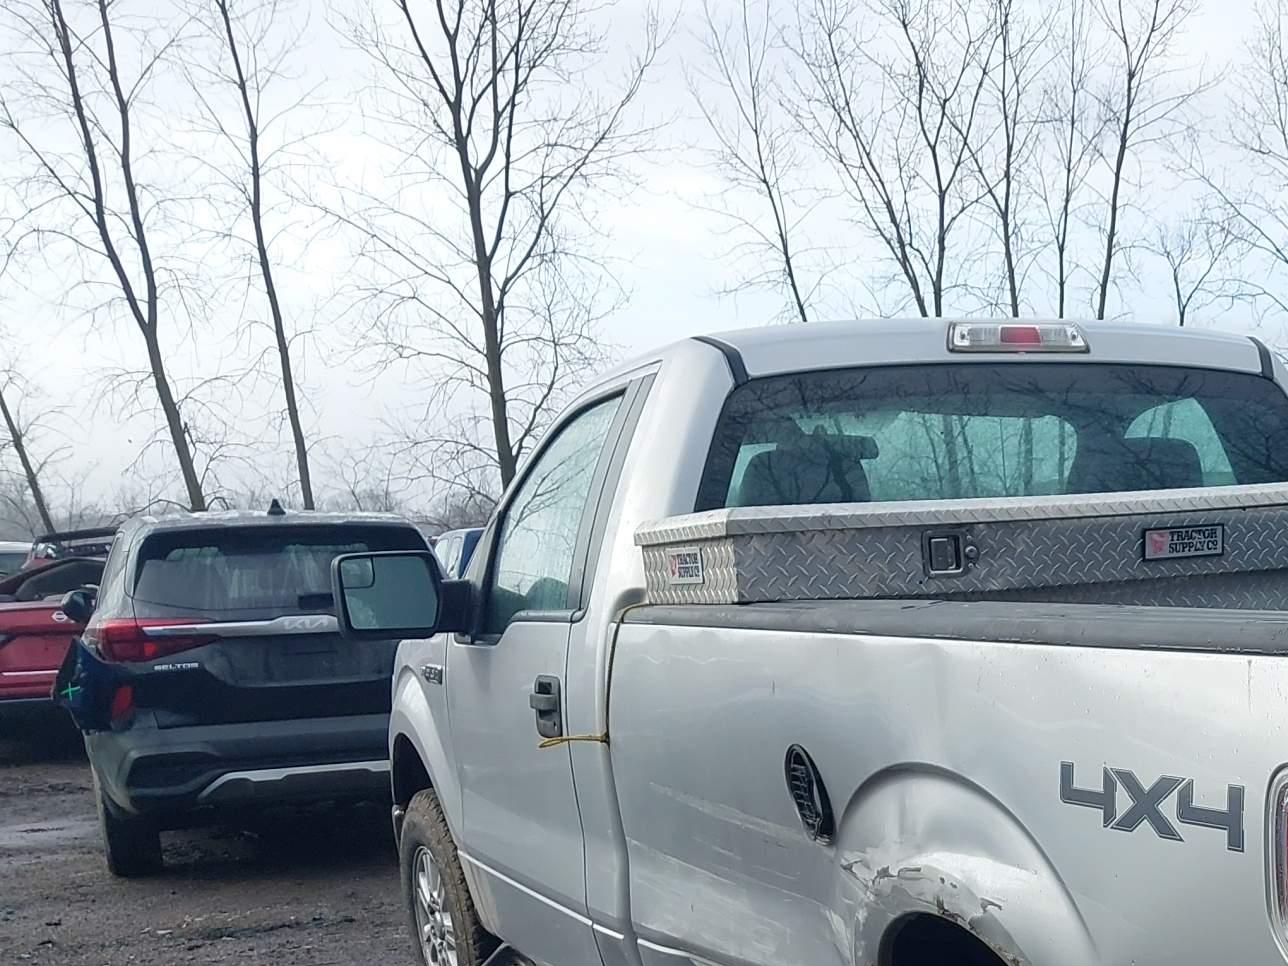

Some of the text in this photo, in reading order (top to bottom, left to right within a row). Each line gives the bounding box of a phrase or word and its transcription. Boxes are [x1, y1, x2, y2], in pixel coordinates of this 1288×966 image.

[1168, 527, 1218, 542] TRACTOR
[1168, 540, 1206, 554] SUPPLY
[284, 618, 328, 630] KIA
[153, 662, 200, 671] SELTOS
[1060, 761, 1245, 853] 4X4
